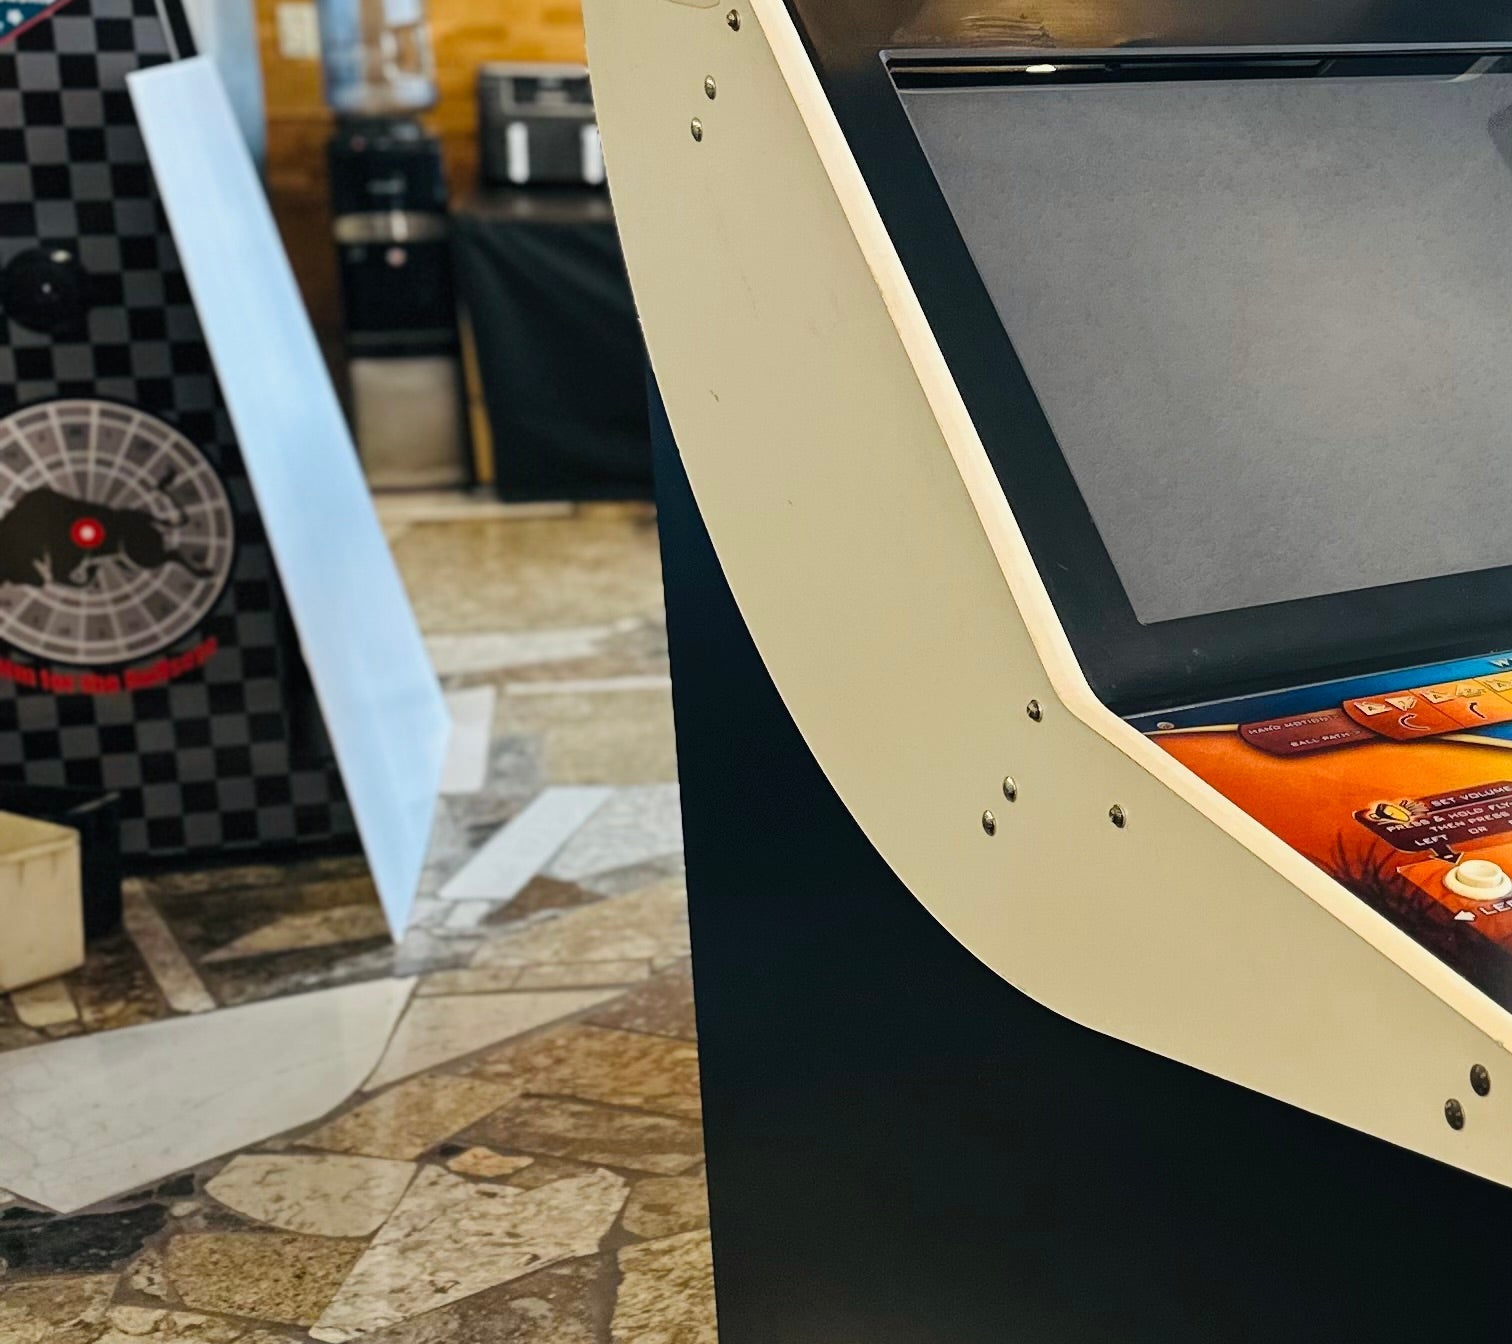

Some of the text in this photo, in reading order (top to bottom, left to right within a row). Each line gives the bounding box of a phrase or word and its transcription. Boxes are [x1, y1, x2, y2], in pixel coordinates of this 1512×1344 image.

[1430, 796, 1458, 808] SET
[1385, 819, 1432, 834] PRESS
[1434, 814, 1446, 824] &
[1448, 806, 1485, 820] HOLD
[1429, 811, 1511, 833] THEN PRESS
[1414, 833, 1450, 847] LEFT
[1468, 825, 1489, 835] OR
